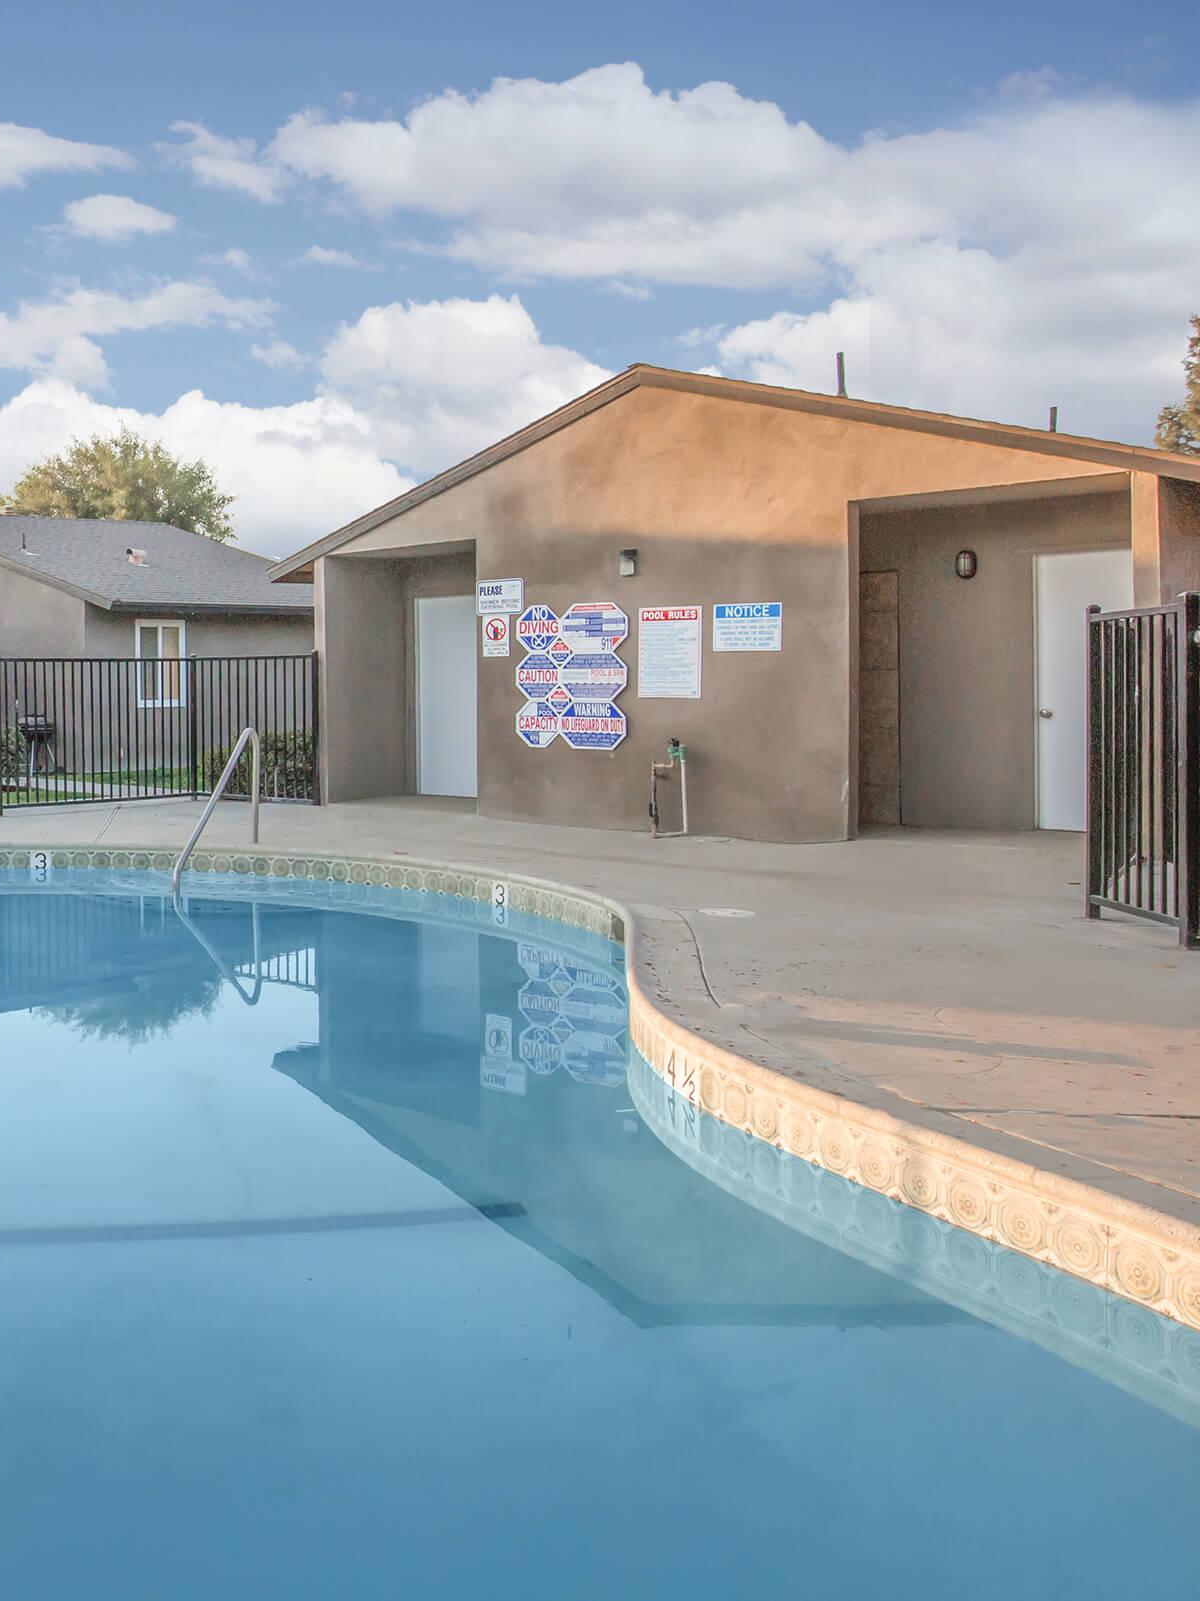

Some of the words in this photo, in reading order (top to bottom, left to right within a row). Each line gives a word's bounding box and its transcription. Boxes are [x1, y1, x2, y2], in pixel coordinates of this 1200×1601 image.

[479, 585, 503, 596] PLEASE
[532, 607, 548, 620] NO
[643, 611, 665, 620] POOL
[668, 610, 696, 619] RULES
[725, 605, 770, 617] NOTICE
[519, 621, 559, 634] DIVING
[601, 637, 612, 650] 911
[518, 670, 558, 682] CAUTION
[591, 669, 607, 677] POOL
[574, 703, 611, 717] WARNING
[519, 717, 558, 730] CAPACITY
[561, 719, 569, 731] NO
[571, 719, 599, 731] LIFEGUARD
[599, 720, 609, 731] ON
[610, 720, 624, 732] DUTY
[35, 852, 47, 869] 3
[495, 884, 505, 905] 3
[668, 1049, 676, 1089] 4
